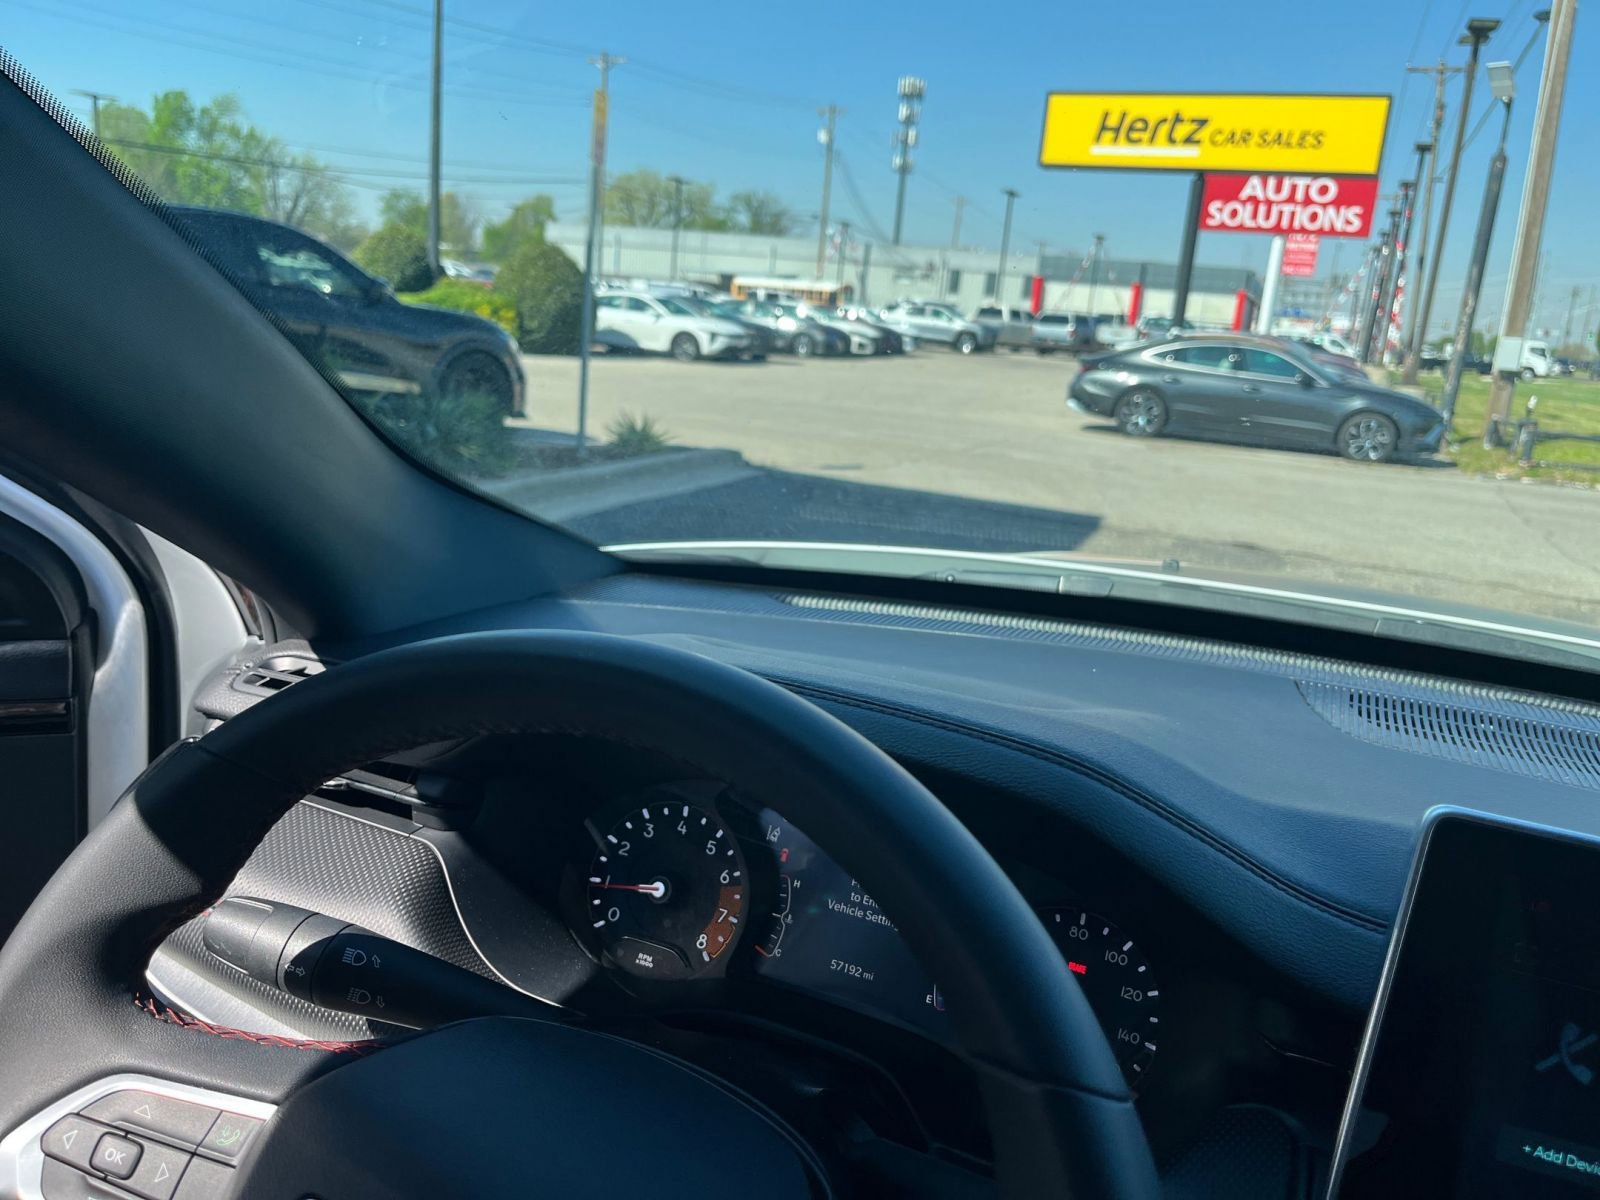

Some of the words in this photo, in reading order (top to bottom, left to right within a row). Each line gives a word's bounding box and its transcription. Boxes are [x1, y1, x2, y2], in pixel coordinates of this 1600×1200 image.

[1095, 111, 1209, 144] Hertz
[1209, 128, 1251, 147] CAR
[1255, 129, 1326, 149] SALES
[1239, 175, 1338, 203] AUTO
[1206, 200, 1364, 233] SOLUTIONS
[643, 822, 655, 838] 3
[677, 820, 687, 835] 4
[618, 841, 631, 856] 2
[705, 840, 717, 855] 5
[719, 869, 730, 884] 6
[793, 879, 801, 888] H
[850, 892, 861, 902] to
[607, 906, 621, 922] 0
[717, 908, 728, 923] 7
[827, 898, 864, 919] Vehicle
[696, 933, 708, 949] 8
[1069, 925, 1089, 941] 80
[638, 953, 653, 962] RPM
[1104, 949, 1129, 966] 100
[829, 959, 862, 978] 57192
[862, 970, 875, 981] mi
[925, 994, 933, 1004] E
[1120, 985, 1143, 1002] 120
[1117, 1027, 1140, 1045] 140
[105, 1148, 126, 1165] OK
[1533, 1146, 1563, 1164] Add
